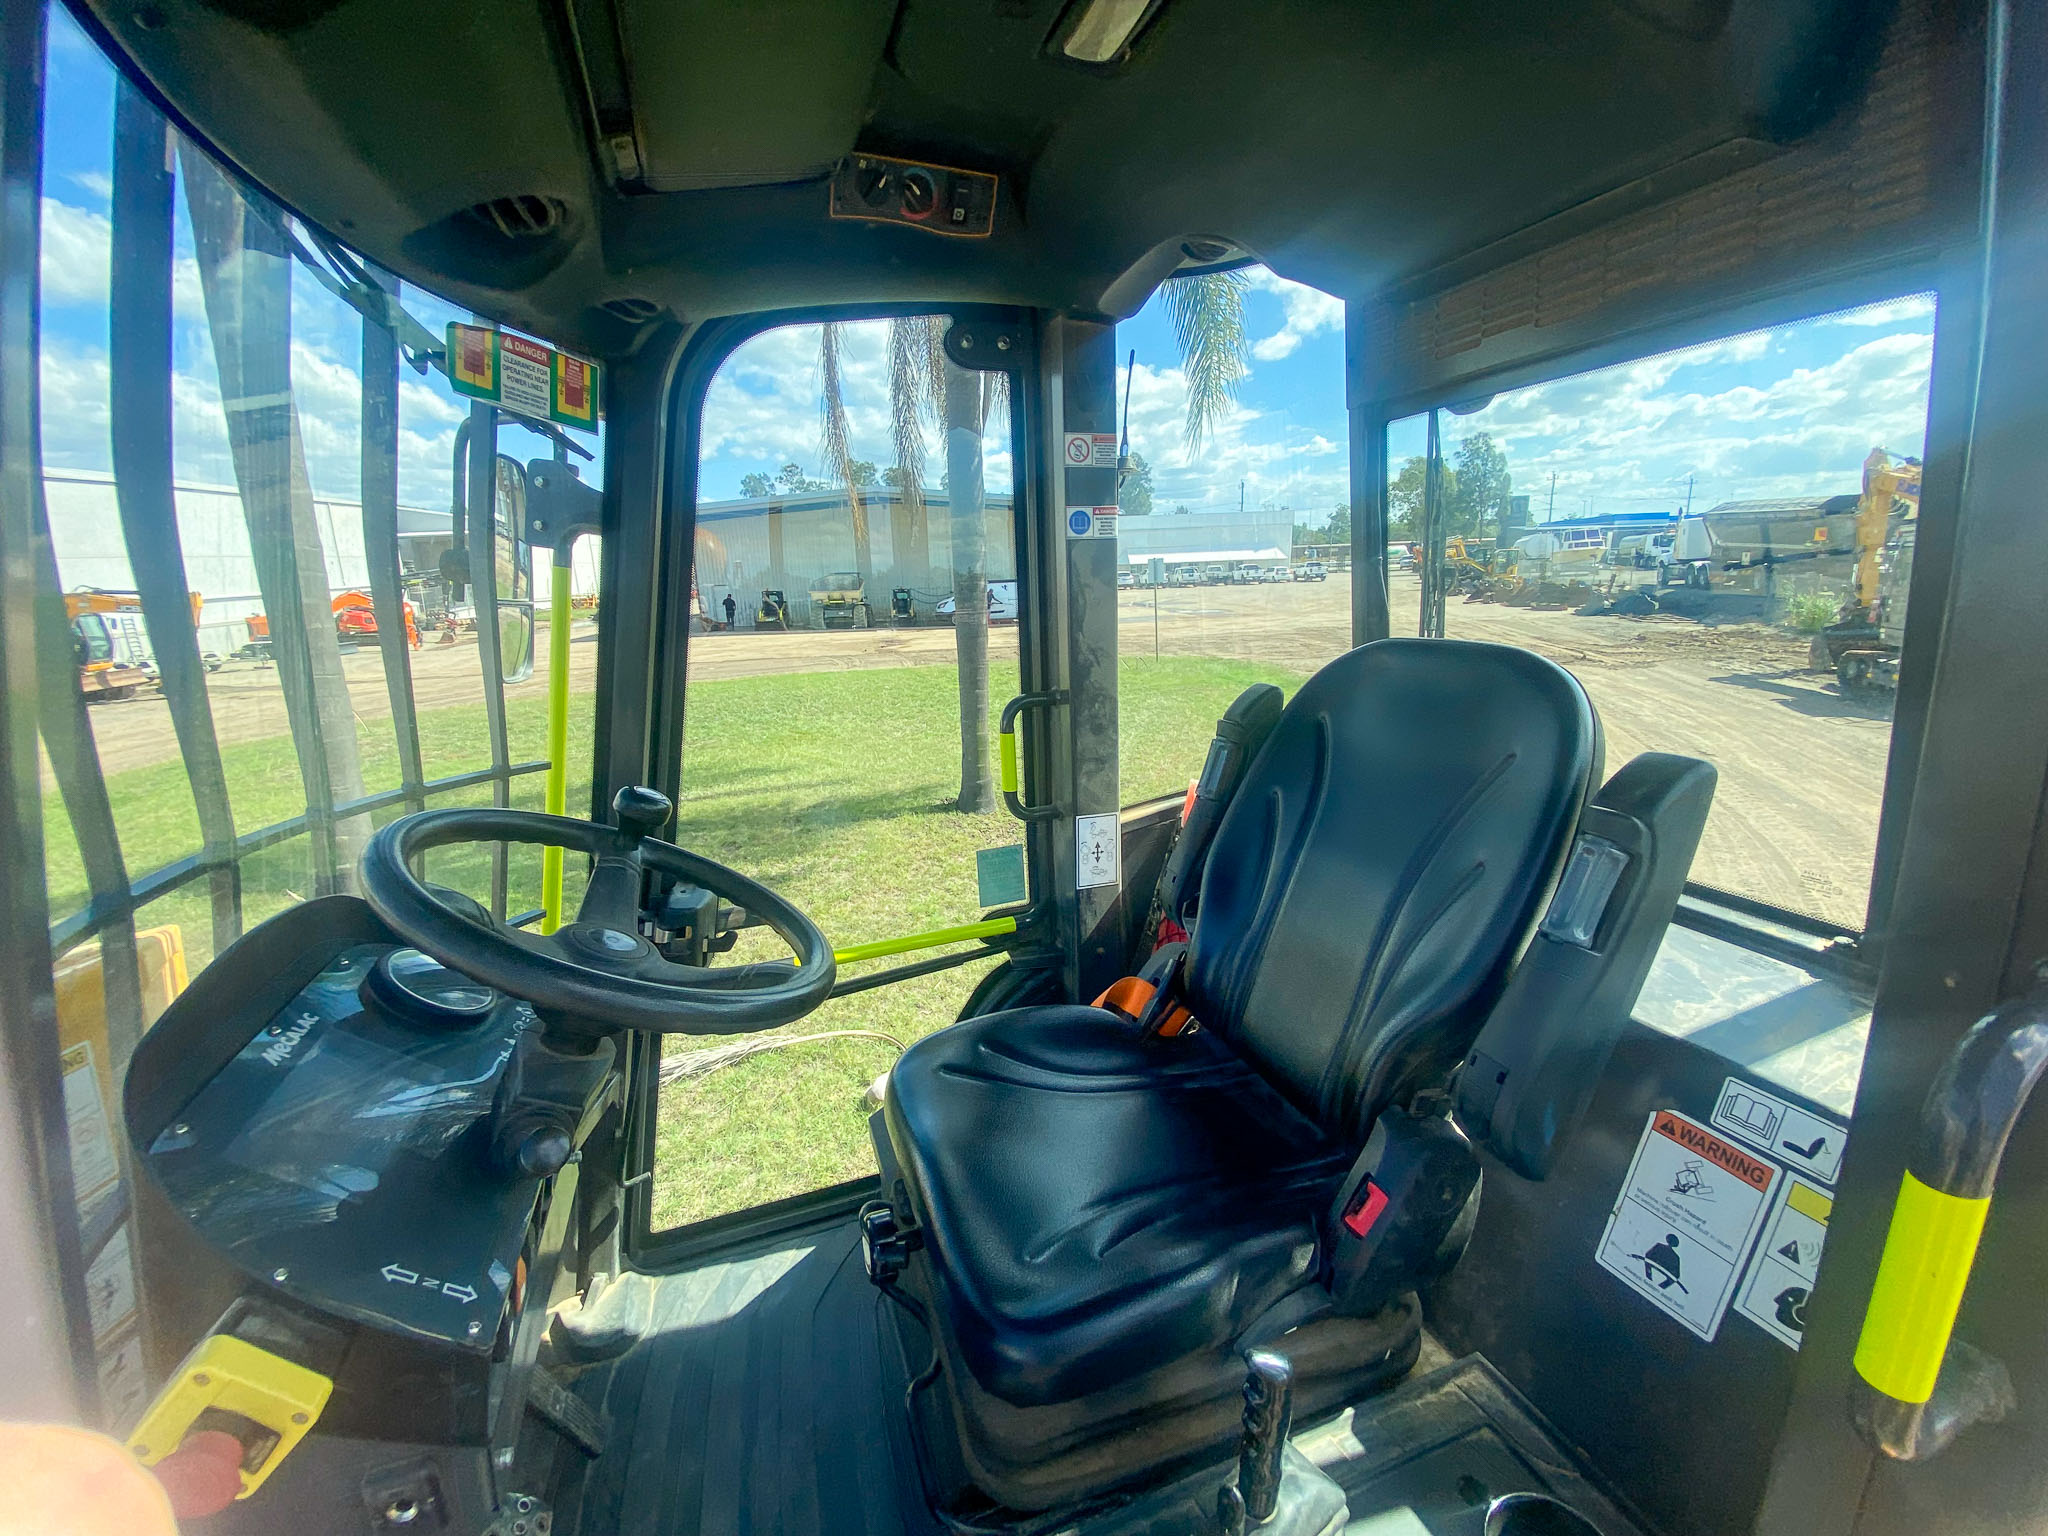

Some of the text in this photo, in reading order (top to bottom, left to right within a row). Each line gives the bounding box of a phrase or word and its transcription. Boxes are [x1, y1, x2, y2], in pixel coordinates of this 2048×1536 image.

[514, 341, 547, 361] DANGER
[502, 364, 549, 386] OPERATING NEAR
[503, 355, 548, 376] CLEARANCE FOR
[506, 374, 527, 386] POWER
[1680, 1125, 1765, 1184] WARNING
